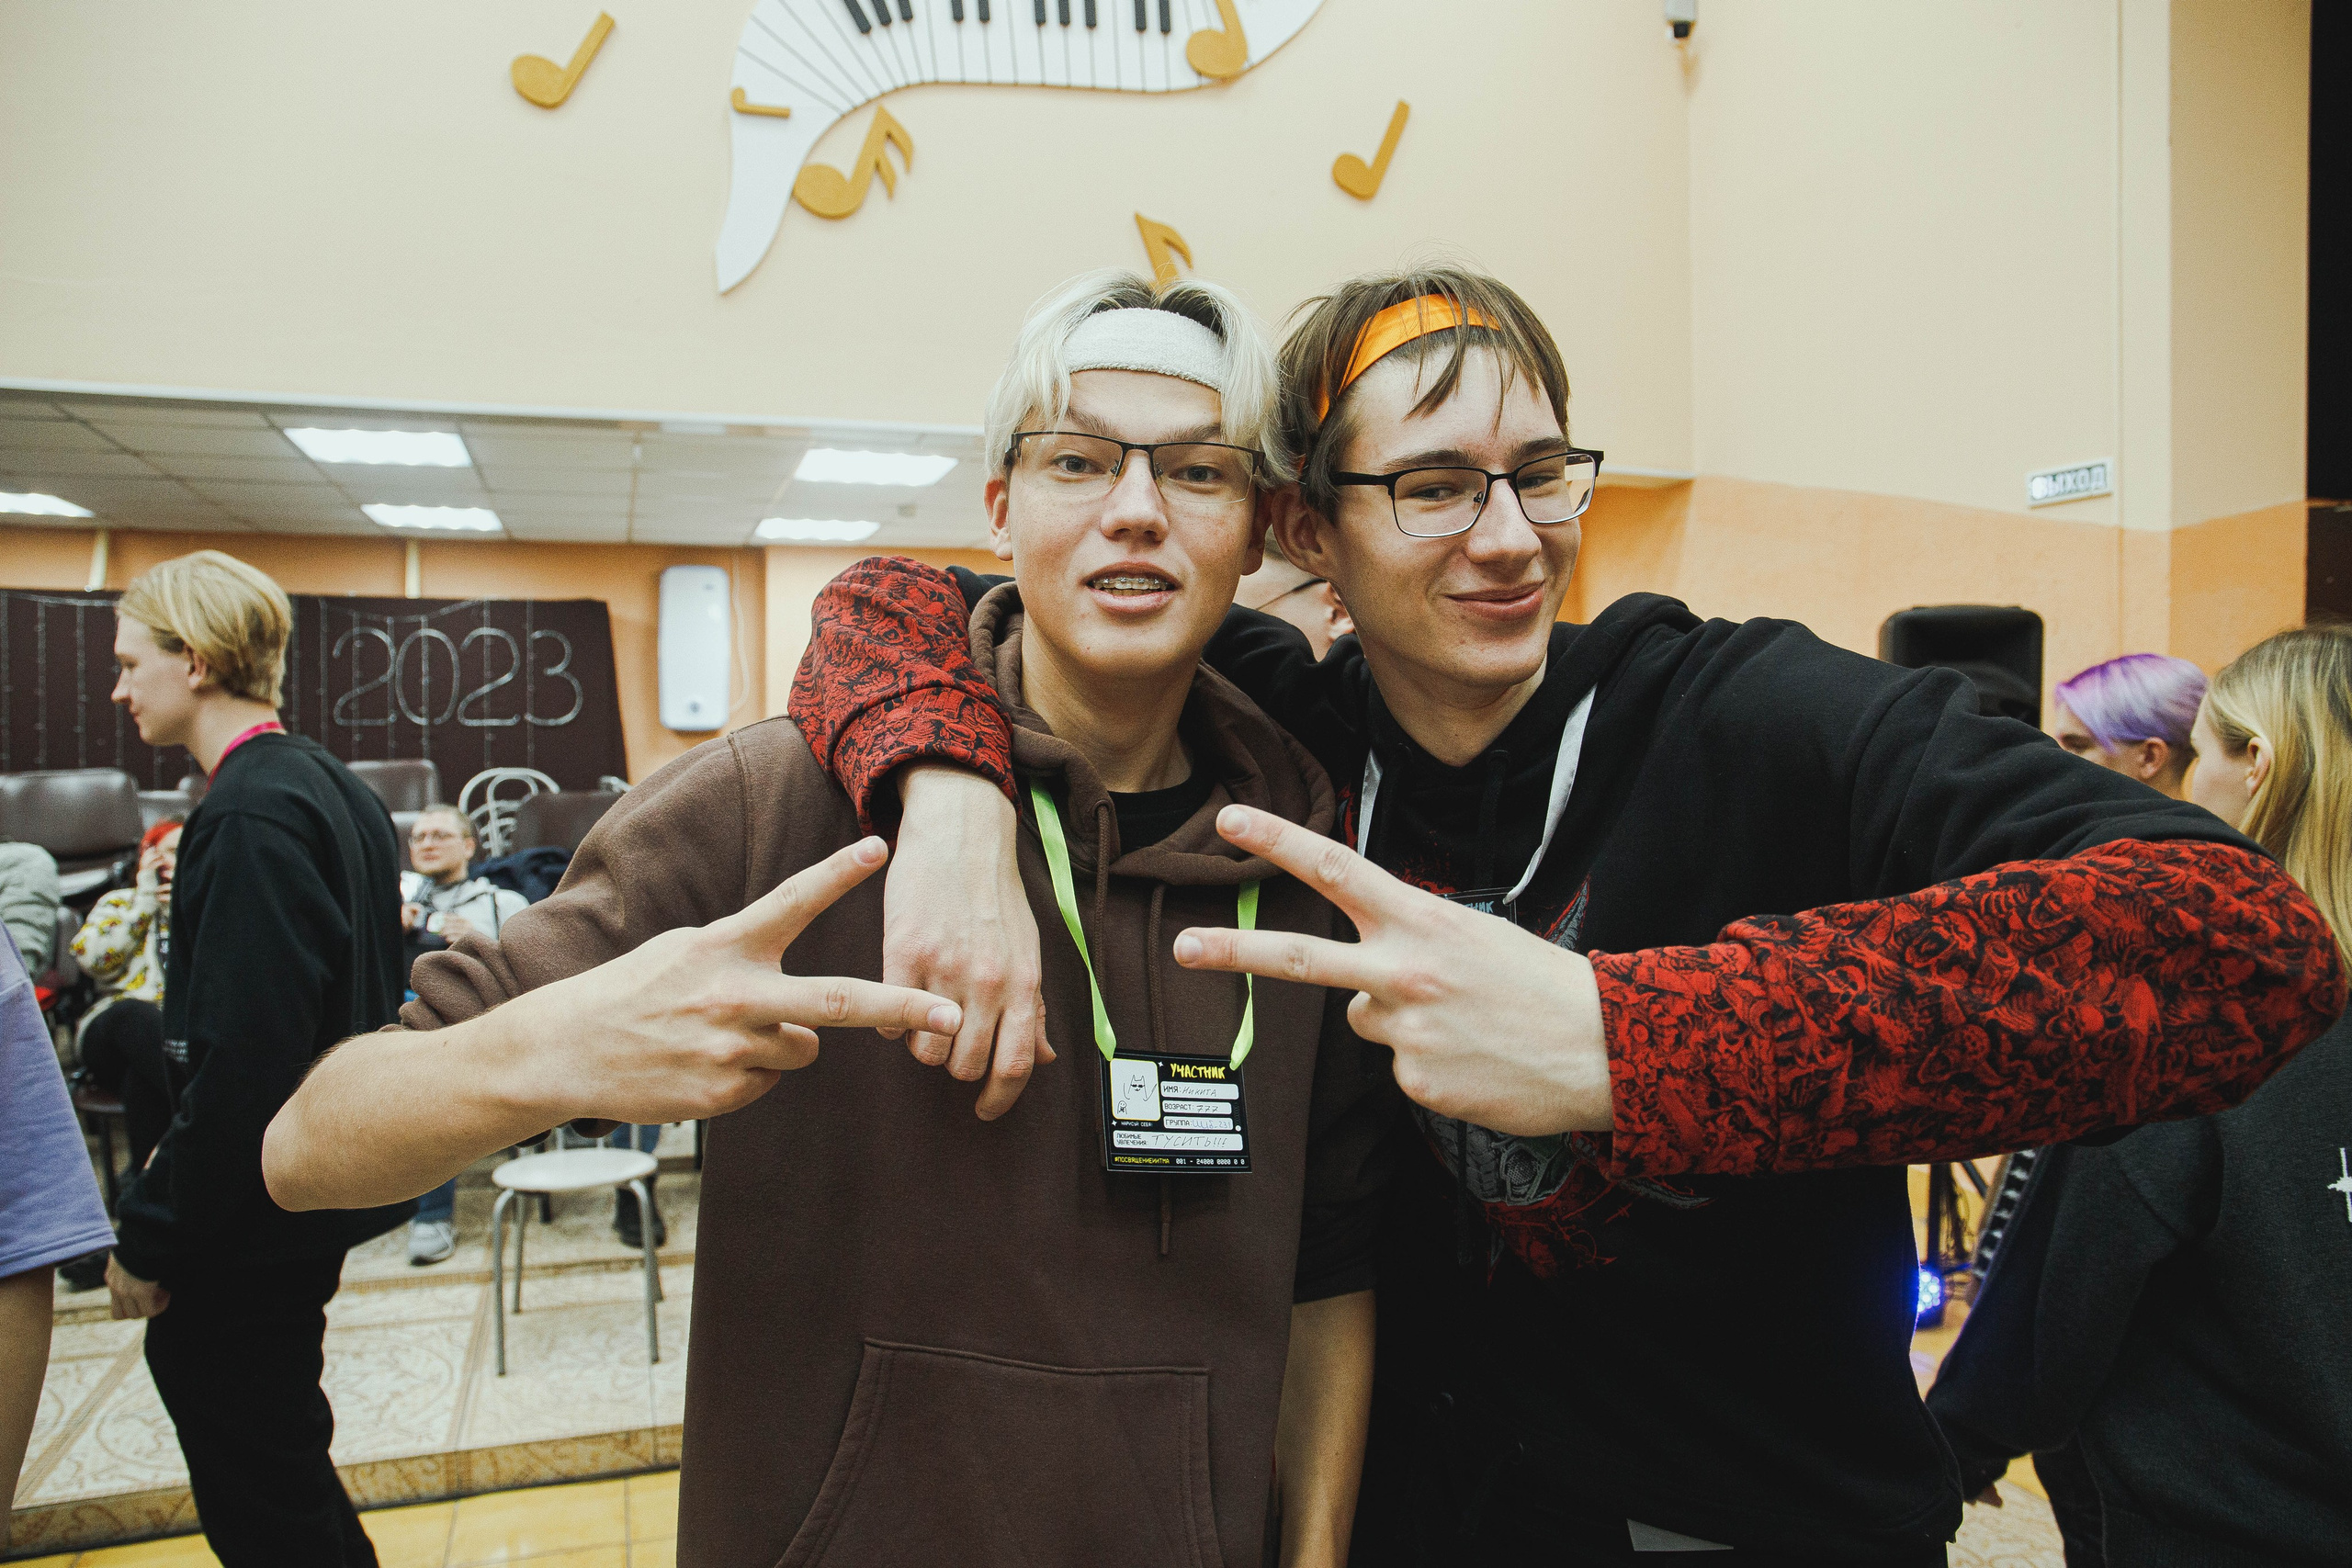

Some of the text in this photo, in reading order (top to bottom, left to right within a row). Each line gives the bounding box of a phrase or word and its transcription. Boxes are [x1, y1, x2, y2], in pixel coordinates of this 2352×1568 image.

[333, 626, 583, 727] 2023
[1170, 1063, 1226, 1079] УЧАСТНИК
[1163, 1085, 1182, 1094] ИМЯ:
[1195, 1105, 1219, 1113] 777
